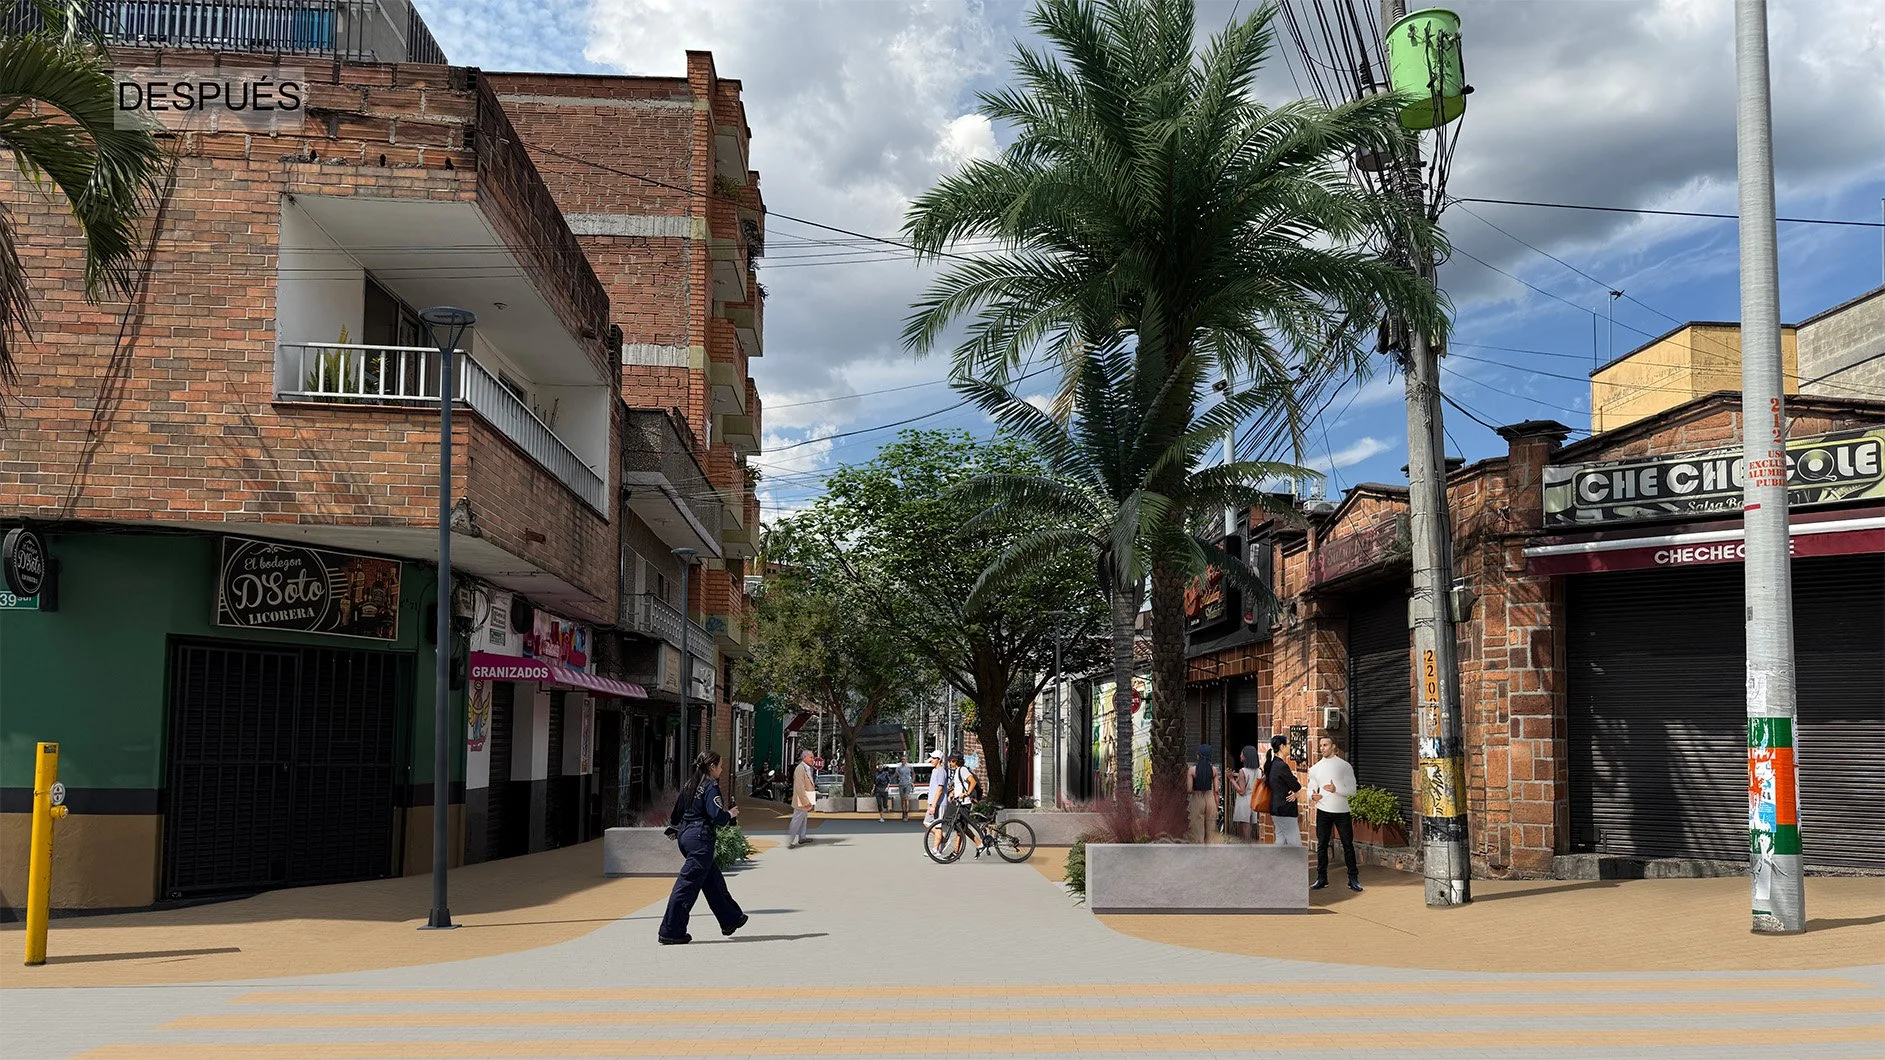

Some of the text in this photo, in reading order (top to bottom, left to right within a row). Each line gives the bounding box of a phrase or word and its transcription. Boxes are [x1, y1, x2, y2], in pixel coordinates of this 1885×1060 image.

[1580, 468, 1658, 502] CHE
[1688, 497, 1744, 513] Salsa Ba
[244, 556, 302, 571] El bodegon
[0, 593, 17, 607] 39
[248, 607, 315, 625] LICORERA
[472, 666, 549, 679] GRANIZADOS
